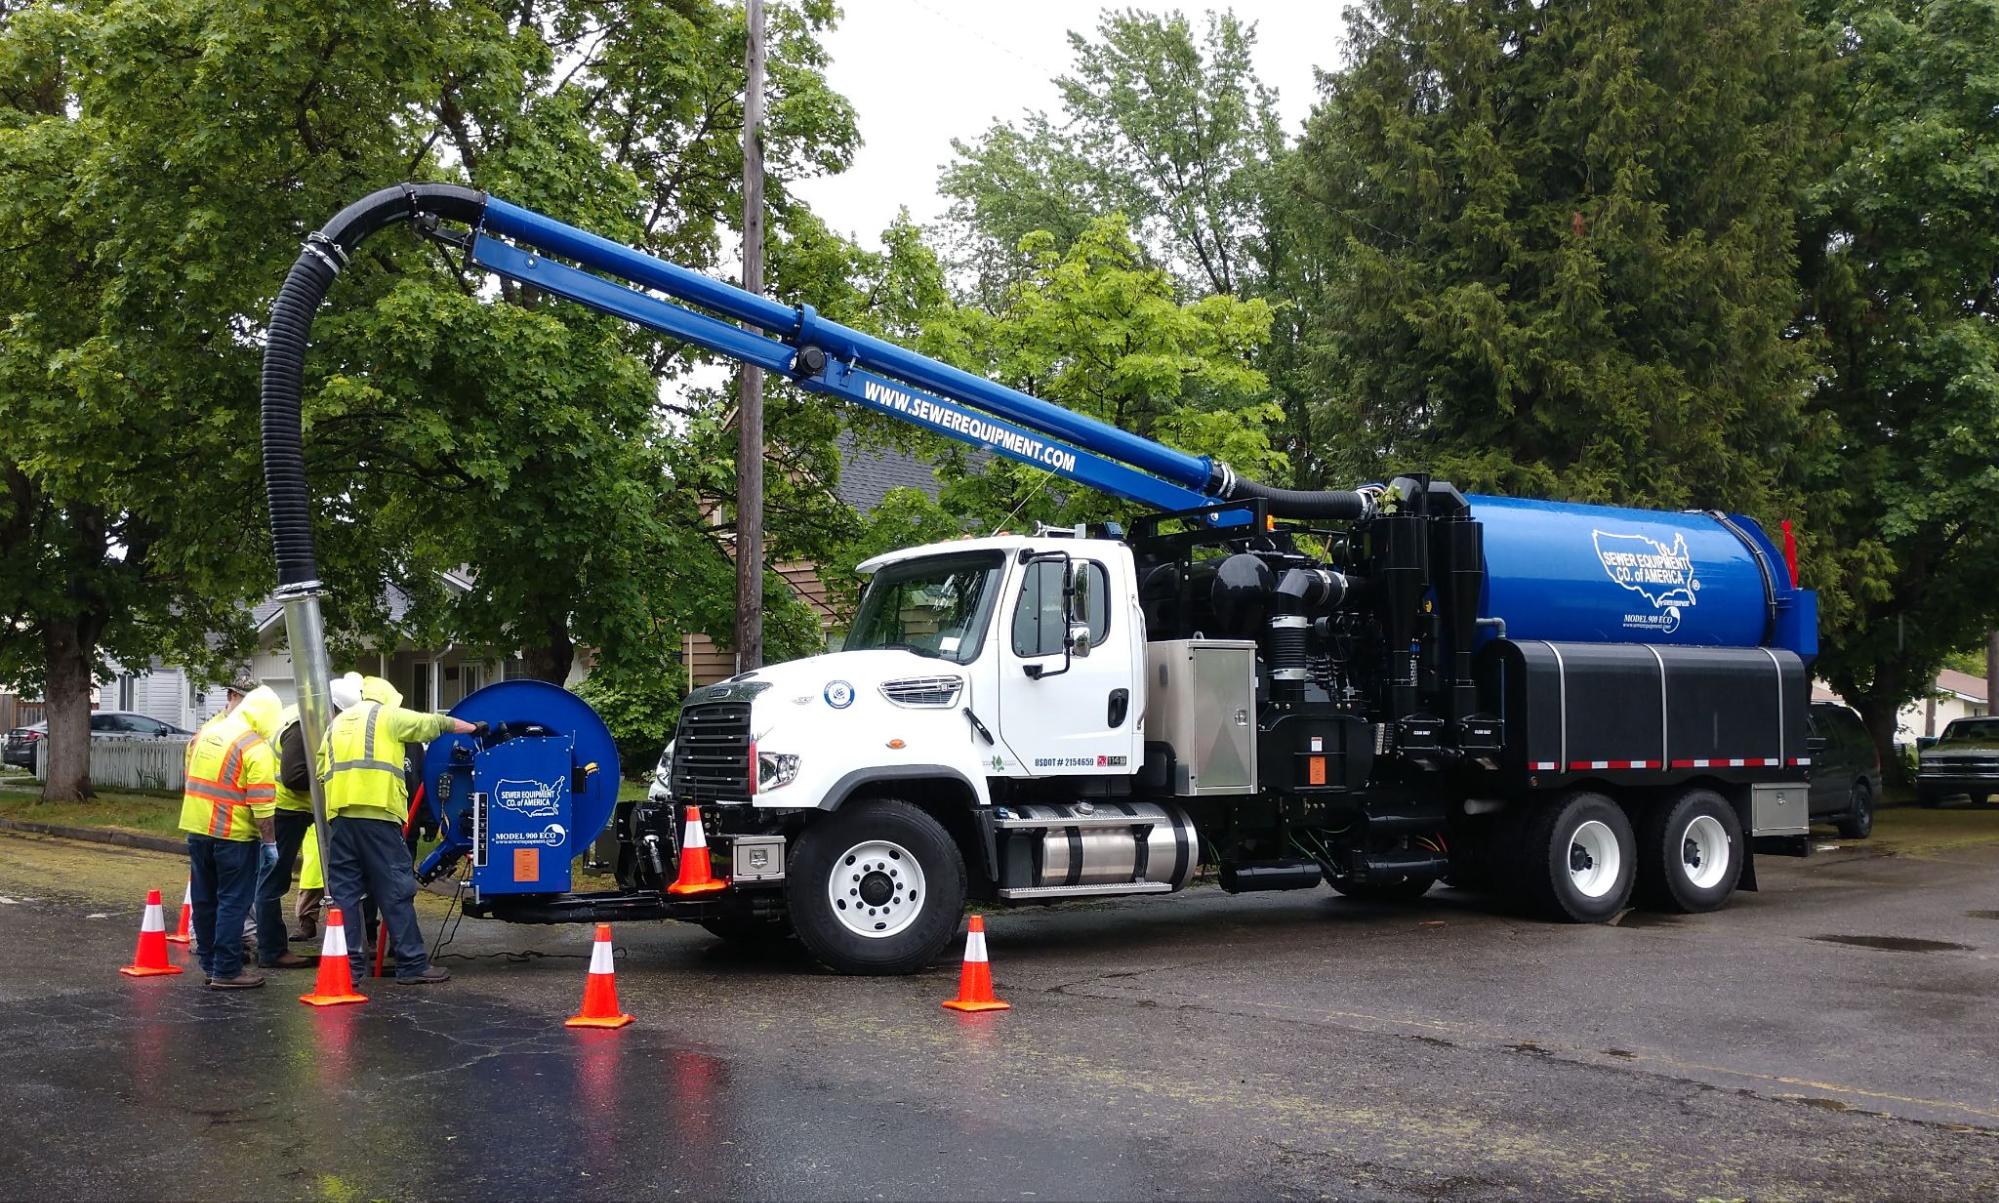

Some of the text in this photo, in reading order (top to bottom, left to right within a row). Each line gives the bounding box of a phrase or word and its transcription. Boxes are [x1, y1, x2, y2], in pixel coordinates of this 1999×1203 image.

[865, 381, 1076, 472] WWW.SEWEREQUIPMENT.COM
[1602, 551, 1688, 570] SEWER EQUIPMENT
[1616, 567, 1634, 582] CO.
[1645, 569, 1685, 585] AMERICA
[1623, 614, 1648, 623] MODEL
[1658, 615, 1673, 624] ECO
[1057, 758, 1064, 767] #
[501, 790, 555, 799] SEWER EQUIPMENT
[506, 798, 516, 807] CO.
[524, 798, 551, 807] AMERICA
